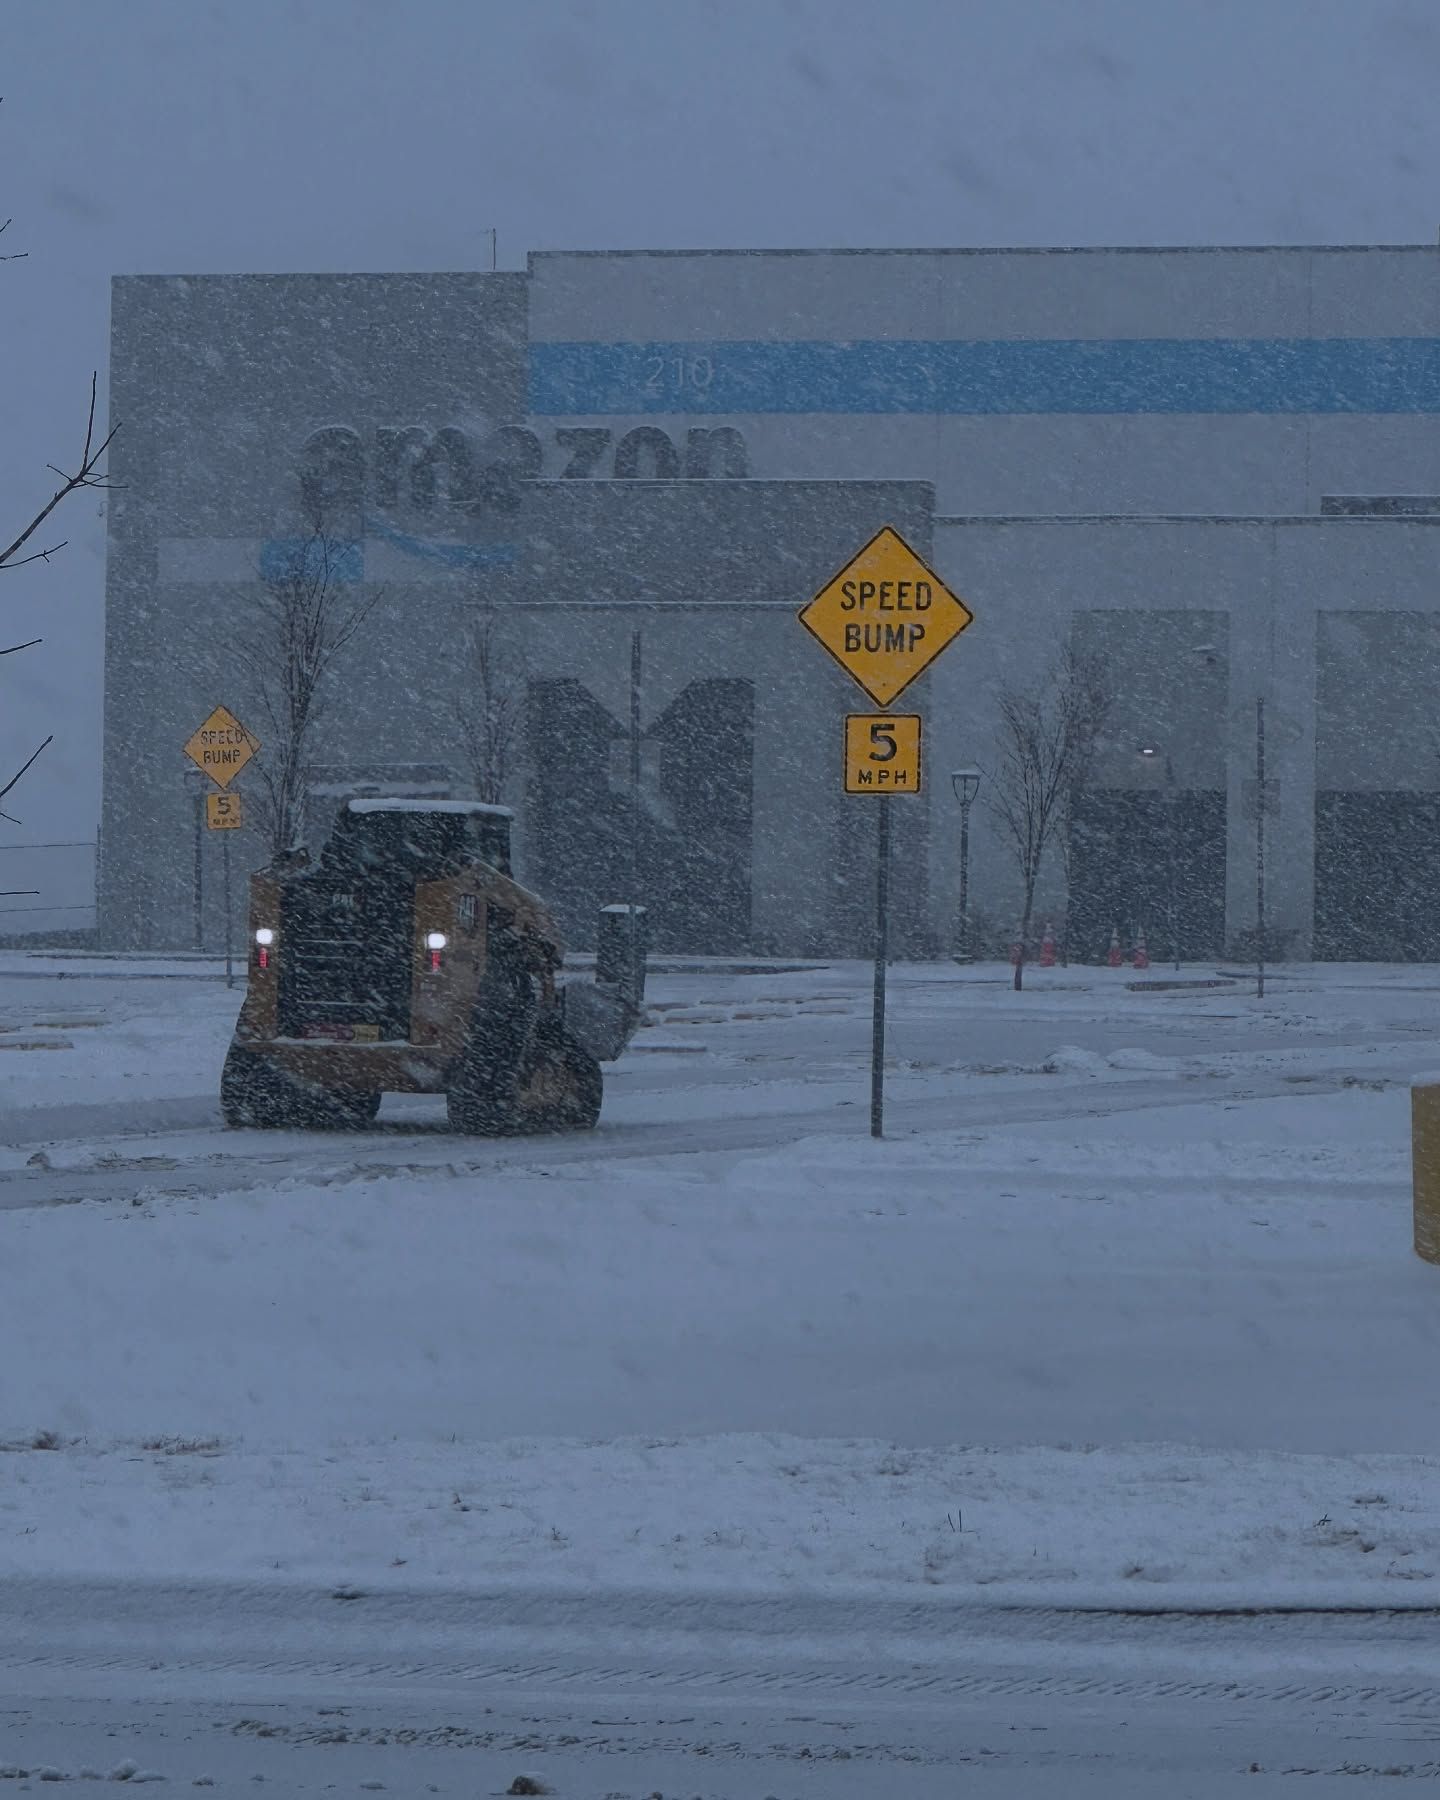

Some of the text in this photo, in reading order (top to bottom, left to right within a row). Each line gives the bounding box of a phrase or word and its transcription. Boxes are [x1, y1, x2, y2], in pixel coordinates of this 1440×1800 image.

[646, 356, 712, 389] 210
[302, 425, 748, 513] amazon
[841, 581, 932, 611] SPEED
[845, 624, 925, 653] BUMP
[201, 730, 244, 745] SPEED
[869, 724, 897, 762] 5
[203, 750, 240, 764] BUMP
[858, 769, 907, 784] MPH
[218, 797, 232, 815] 5
